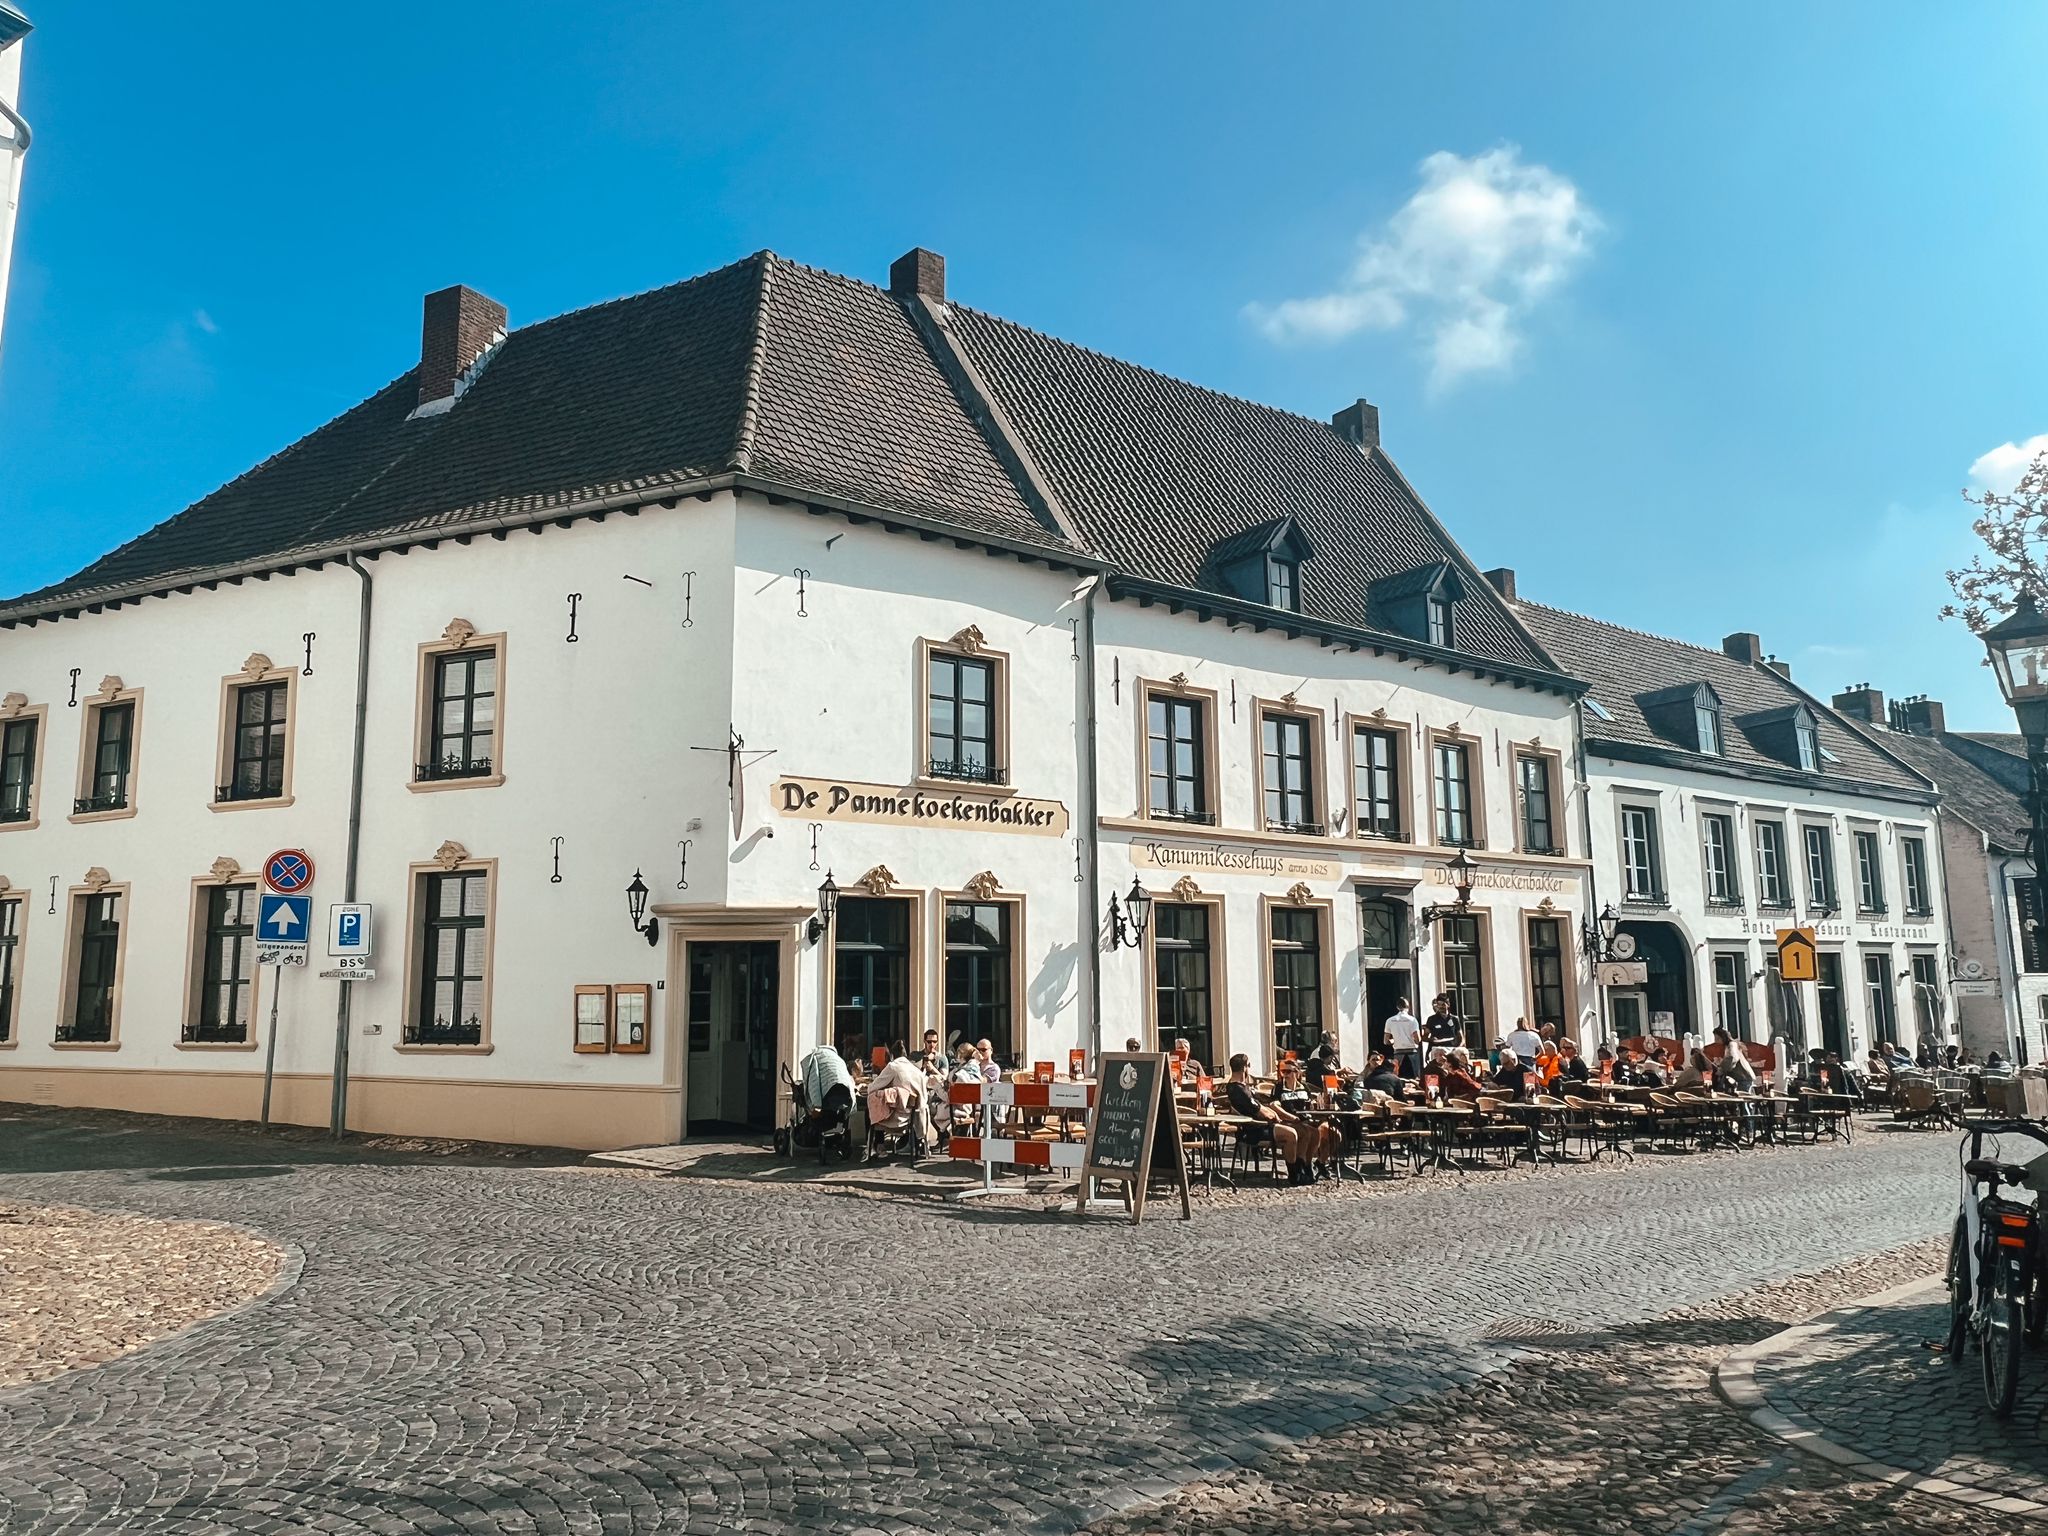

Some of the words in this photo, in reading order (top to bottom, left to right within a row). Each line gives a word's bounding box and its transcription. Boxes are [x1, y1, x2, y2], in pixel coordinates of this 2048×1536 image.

[779, 782, 819, 811] De
[827, 785, 1054, 826] Pannekoekenbakker
[1146, 843, 1284, 876] Kanunnikessehuys
[1288, 864, 1308, 873] anno
[1310, 864, 1328, 875] 1625
[1434, 867, 1453, 884] De
[343, 915, 357, 933] P
[1740, 918, 1775, 934] Hotel
[1792, 951, 1800, 969] 1
